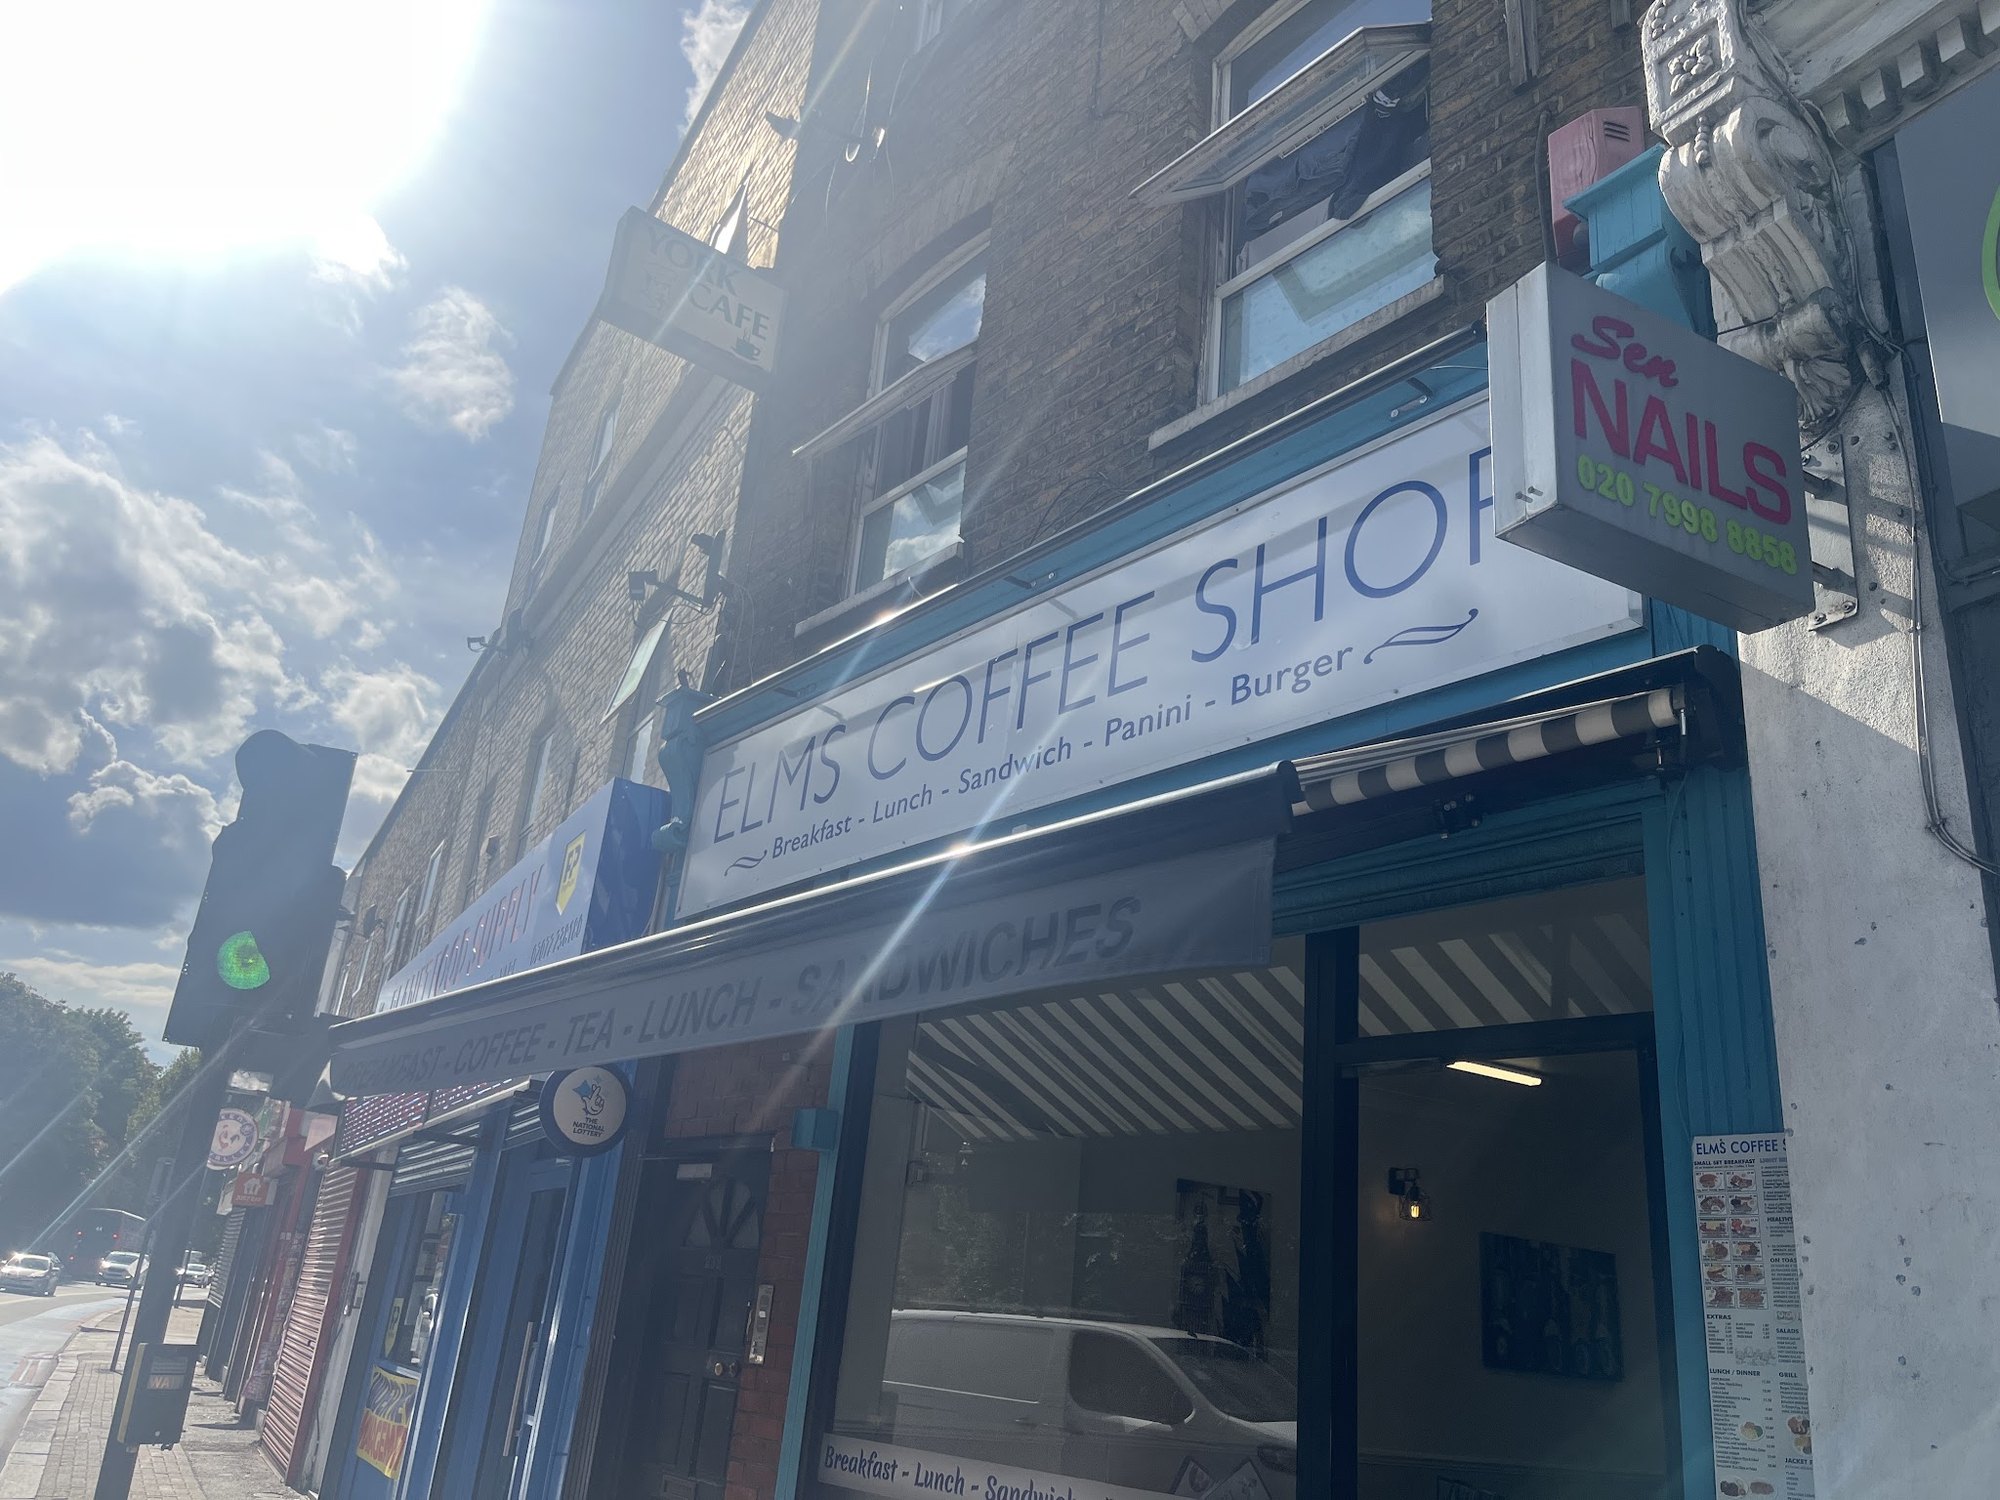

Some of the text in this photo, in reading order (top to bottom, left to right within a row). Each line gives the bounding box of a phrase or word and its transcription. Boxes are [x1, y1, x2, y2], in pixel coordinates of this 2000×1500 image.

[689, 284, 770, 340] CAFE
[1571, 315, 1679, 387] Sen
[1571, 358, 1791, 525] NAILS
[1577, 454, 1798, 575] 020 7998 8858
[713, 723, 846, 844] ELMS
[868, 589, 1156, 781] COFFEE
[771, 814, 852, 859] Breakfast
[872, 784, 933, 824] Lunch
[958, 737, 1072, 795] Sandwich
[1105, 694, 1192, 747] Panini
[1231, 646, 1354, 705] Burger
[467, 863, 545, 976] SUPPLY
[453, 1022, 546, 1076] COFFEE
[562, 1008, 617, 1056] TEA
[638, 978, 756, 1043] LUNCH
[790, 896, 1142, 1015] SANDWICHES
[573, 1121, 605, 1132] NATIONAL
[573, 1127, 602, 1137] LOTTERY
[585, 1117, 598, 1125] THE
[1730, 1139, 1778, 1154] COFFEE
[825, 1446, 899, 1482] Breakfast
[914, 1465, 965, 1496] Lunch
[1785, 1457, 1809, 1465] JACKET
